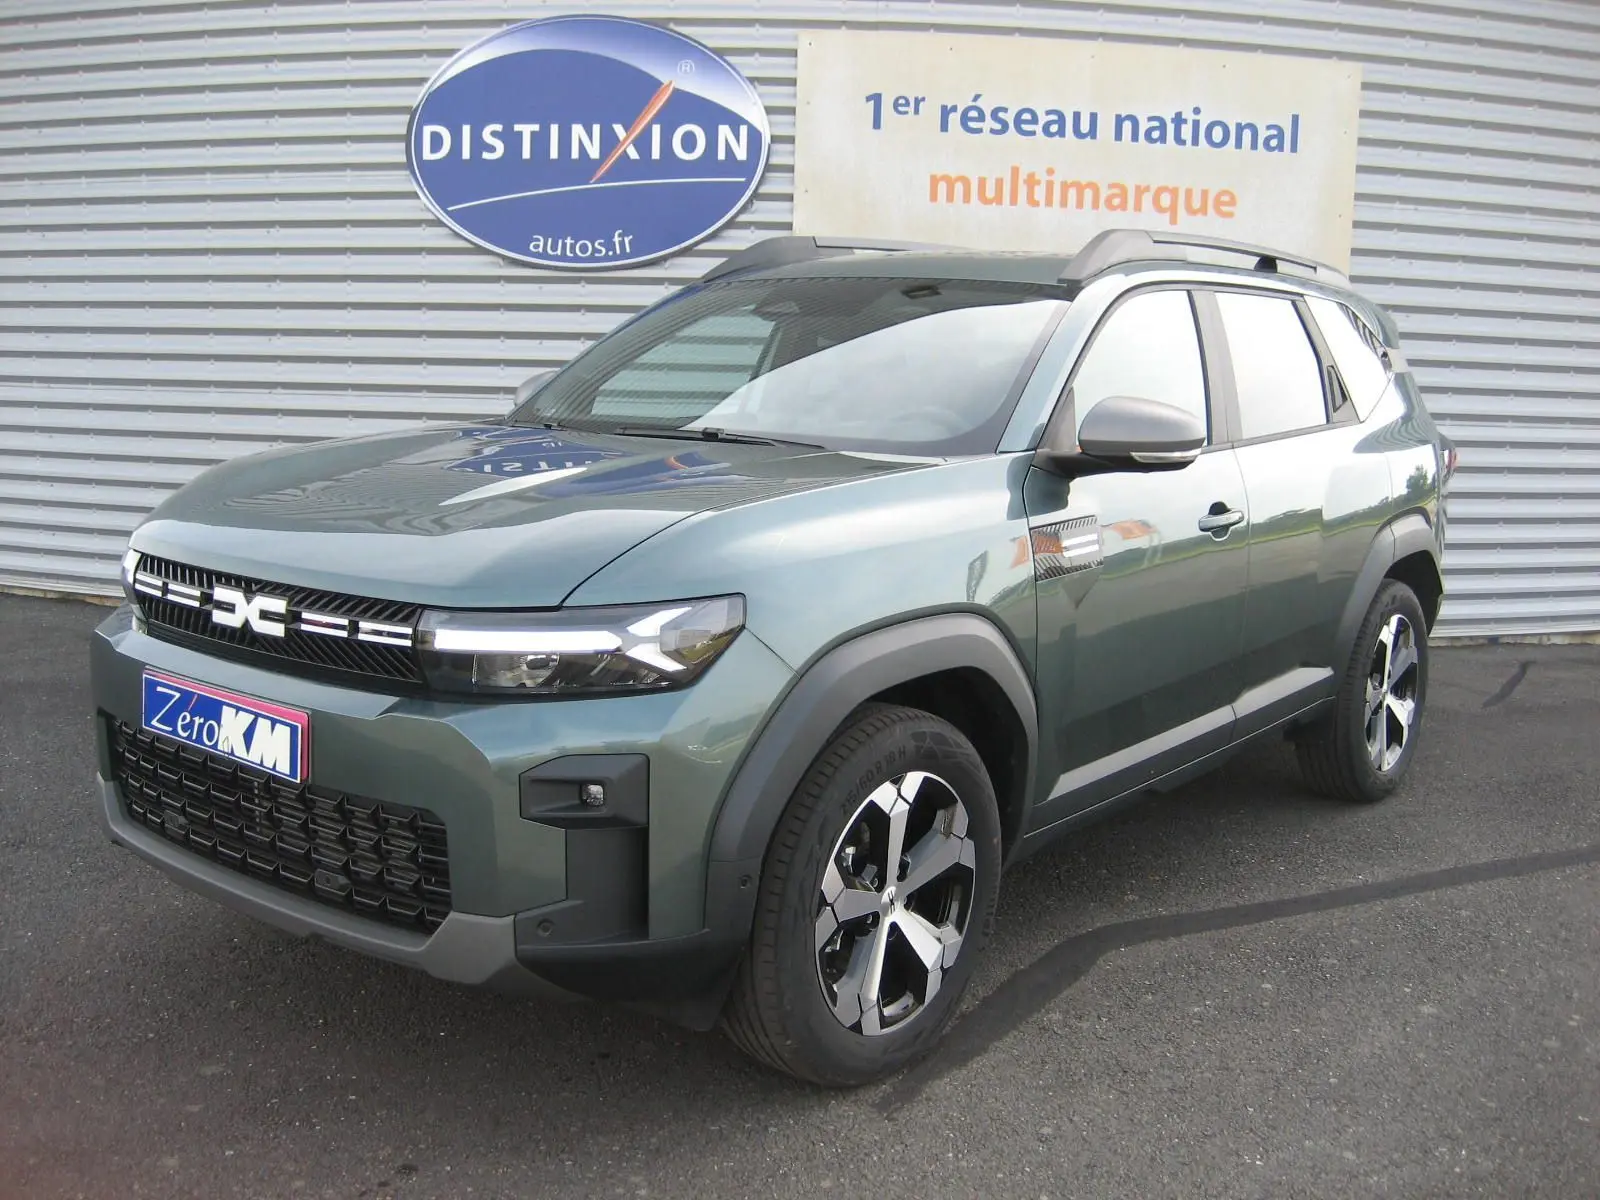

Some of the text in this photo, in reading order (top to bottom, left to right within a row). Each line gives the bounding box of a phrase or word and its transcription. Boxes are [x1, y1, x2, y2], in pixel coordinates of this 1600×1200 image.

[421, 123, 749, 161] DISTINXION
[865, 92, 1300, 154] 1er réseau national
[929, 165, 1237, 226] multimarque
[529, 229, 634, 258] autos.fr
